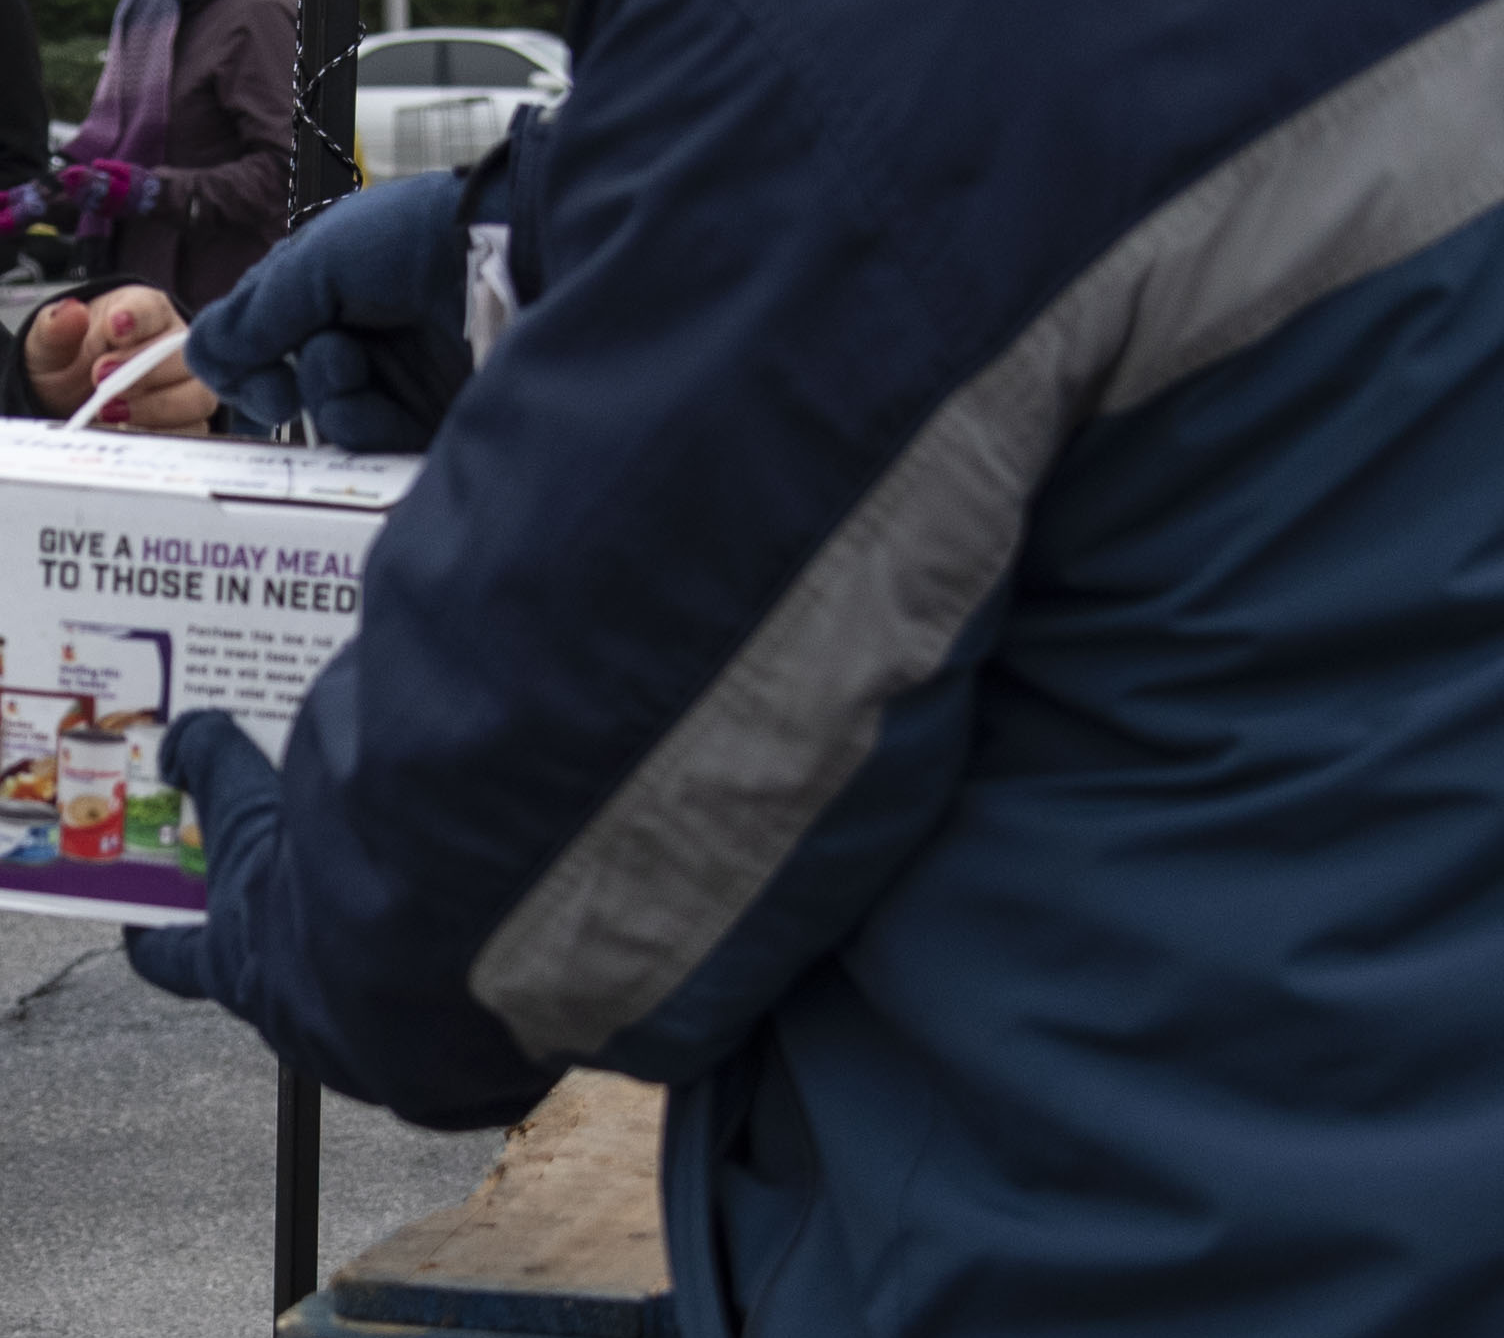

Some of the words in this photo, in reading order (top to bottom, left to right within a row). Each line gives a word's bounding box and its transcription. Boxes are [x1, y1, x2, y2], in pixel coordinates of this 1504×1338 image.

[39, 528, 104, 558] GIVE
[113, 535, 132, 559] A
[142, 536, 266, 573] HOLIDAY
[276, 548, 360, 580] MEAL
[39, 559, 80, 591] TO
[92, 563, 203, 601] THOSE
[215, 575, 250, 604] IN
[262, 579, 359, 614] NEED
